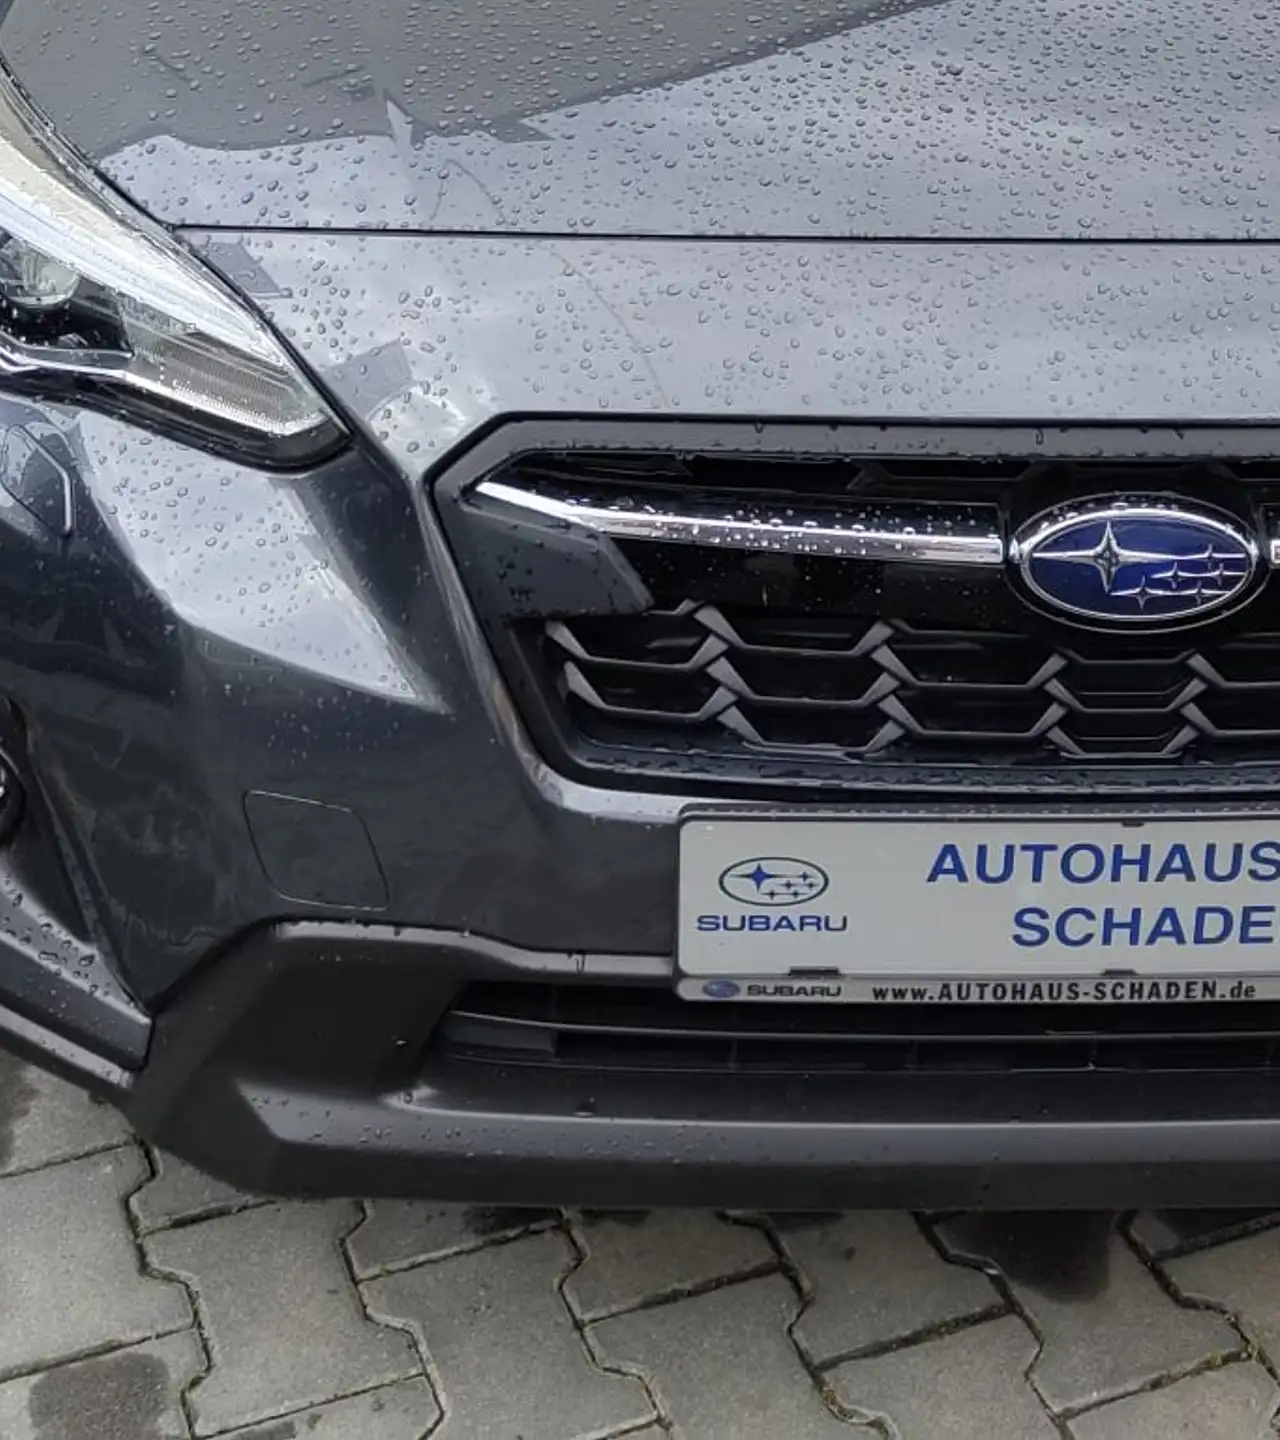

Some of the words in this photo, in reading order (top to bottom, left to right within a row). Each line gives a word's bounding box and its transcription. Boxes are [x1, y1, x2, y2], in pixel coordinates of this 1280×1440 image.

[696, 914, 848, 933] SUBARU
[746, 983, 842, 998] SUBARU
[872, 979, 1256, 1002] www.AUTOHAUS-SCHADEN.de
